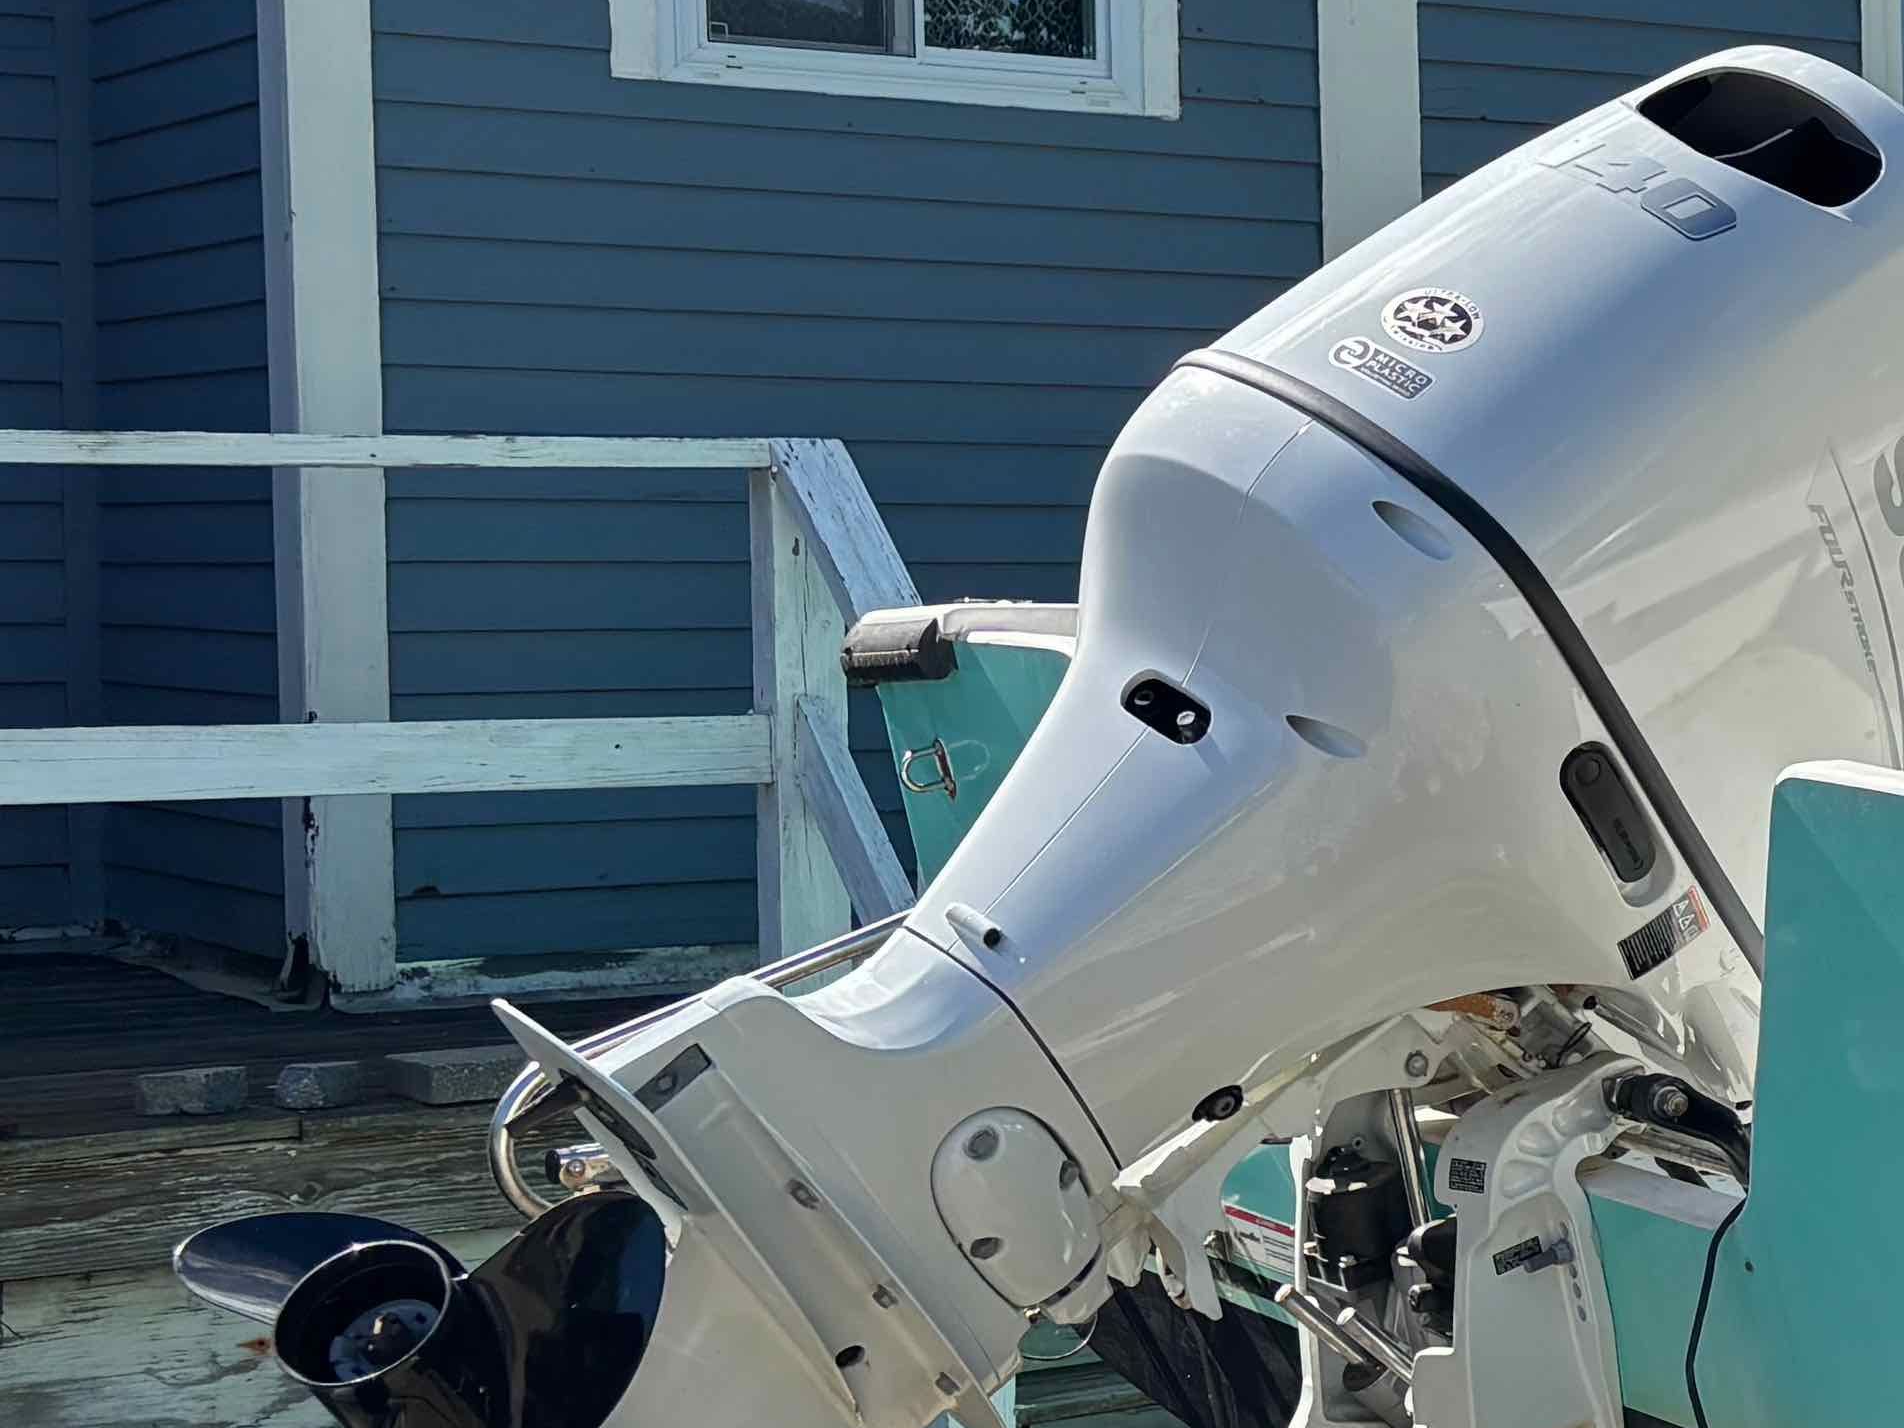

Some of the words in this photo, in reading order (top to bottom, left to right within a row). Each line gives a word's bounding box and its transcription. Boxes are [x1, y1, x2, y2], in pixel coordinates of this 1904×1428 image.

[1536, 138, 1737, 241] 140
[1366, 360, 1422, 393] PLASTIC
[1375, 353, 1428, 385] MICRO
[1807, 504, 1853, 589] FOUR
